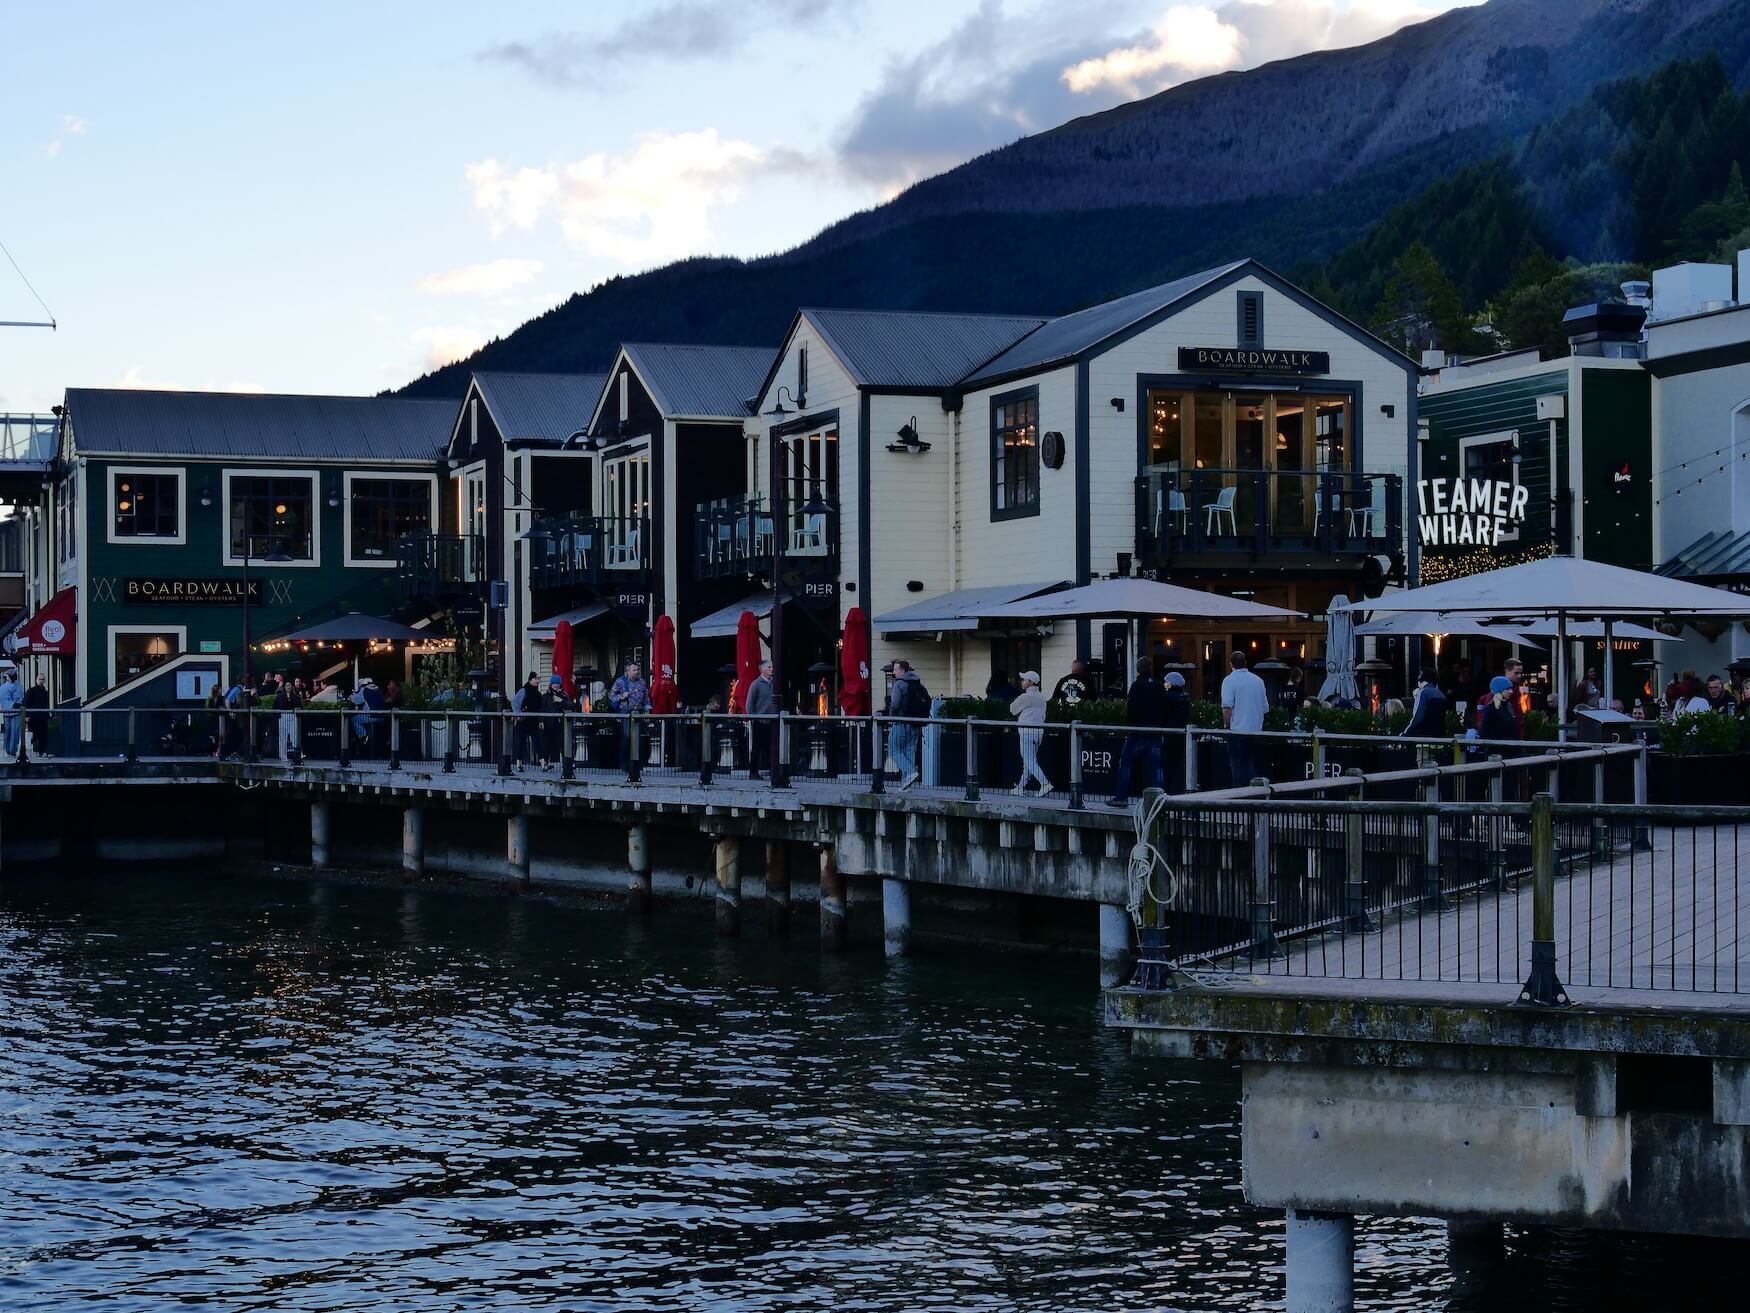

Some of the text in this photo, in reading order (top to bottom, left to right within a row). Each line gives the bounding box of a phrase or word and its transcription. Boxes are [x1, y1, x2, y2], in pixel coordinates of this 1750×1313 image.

[1198, 351, 1310, 366] BOARDWALK
[1418, 514, 1507, 546] WHARF
[128, 582, 257, 595] BOARDWALK
[806, 584, 832, 594] PIER
[619, 594, 645, 605] PIER
[1081, 750, 1111, 768] PIER
[1305, 762, 1342, 780] PER
